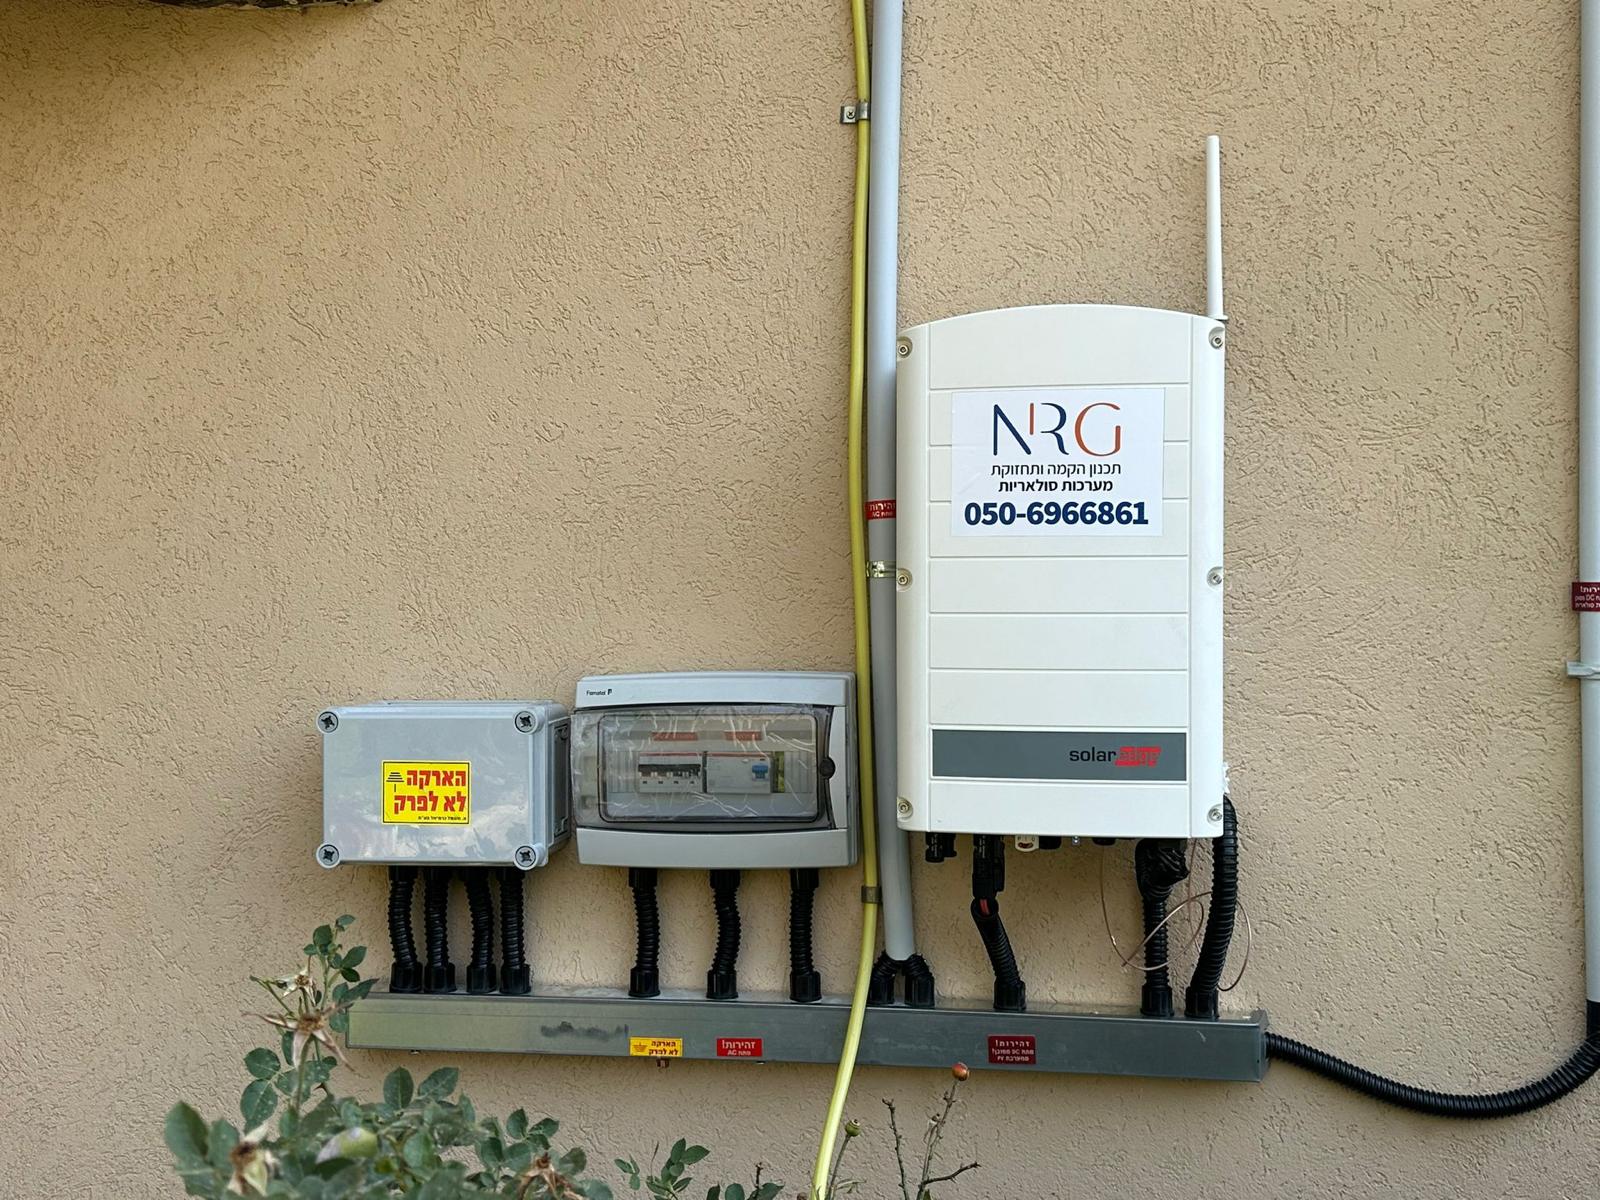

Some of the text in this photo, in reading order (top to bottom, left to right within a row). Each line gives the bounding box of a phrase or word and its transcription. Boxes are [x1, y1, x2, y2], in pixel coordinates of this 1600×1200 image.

[993, 402, 1121, 456] NRG
[991, 463, 1121, 478] תכנון הקמה ותחזוקת
[998, 478, 1113, 492] מערכות סולאריות
[964, 501, 1149, 525] 050-6966861
[407, 770, 466, 790] הארקה
[394, 791, 467, 815] לא לפרק
[722, 1039, 756, 1049] זהירות!
